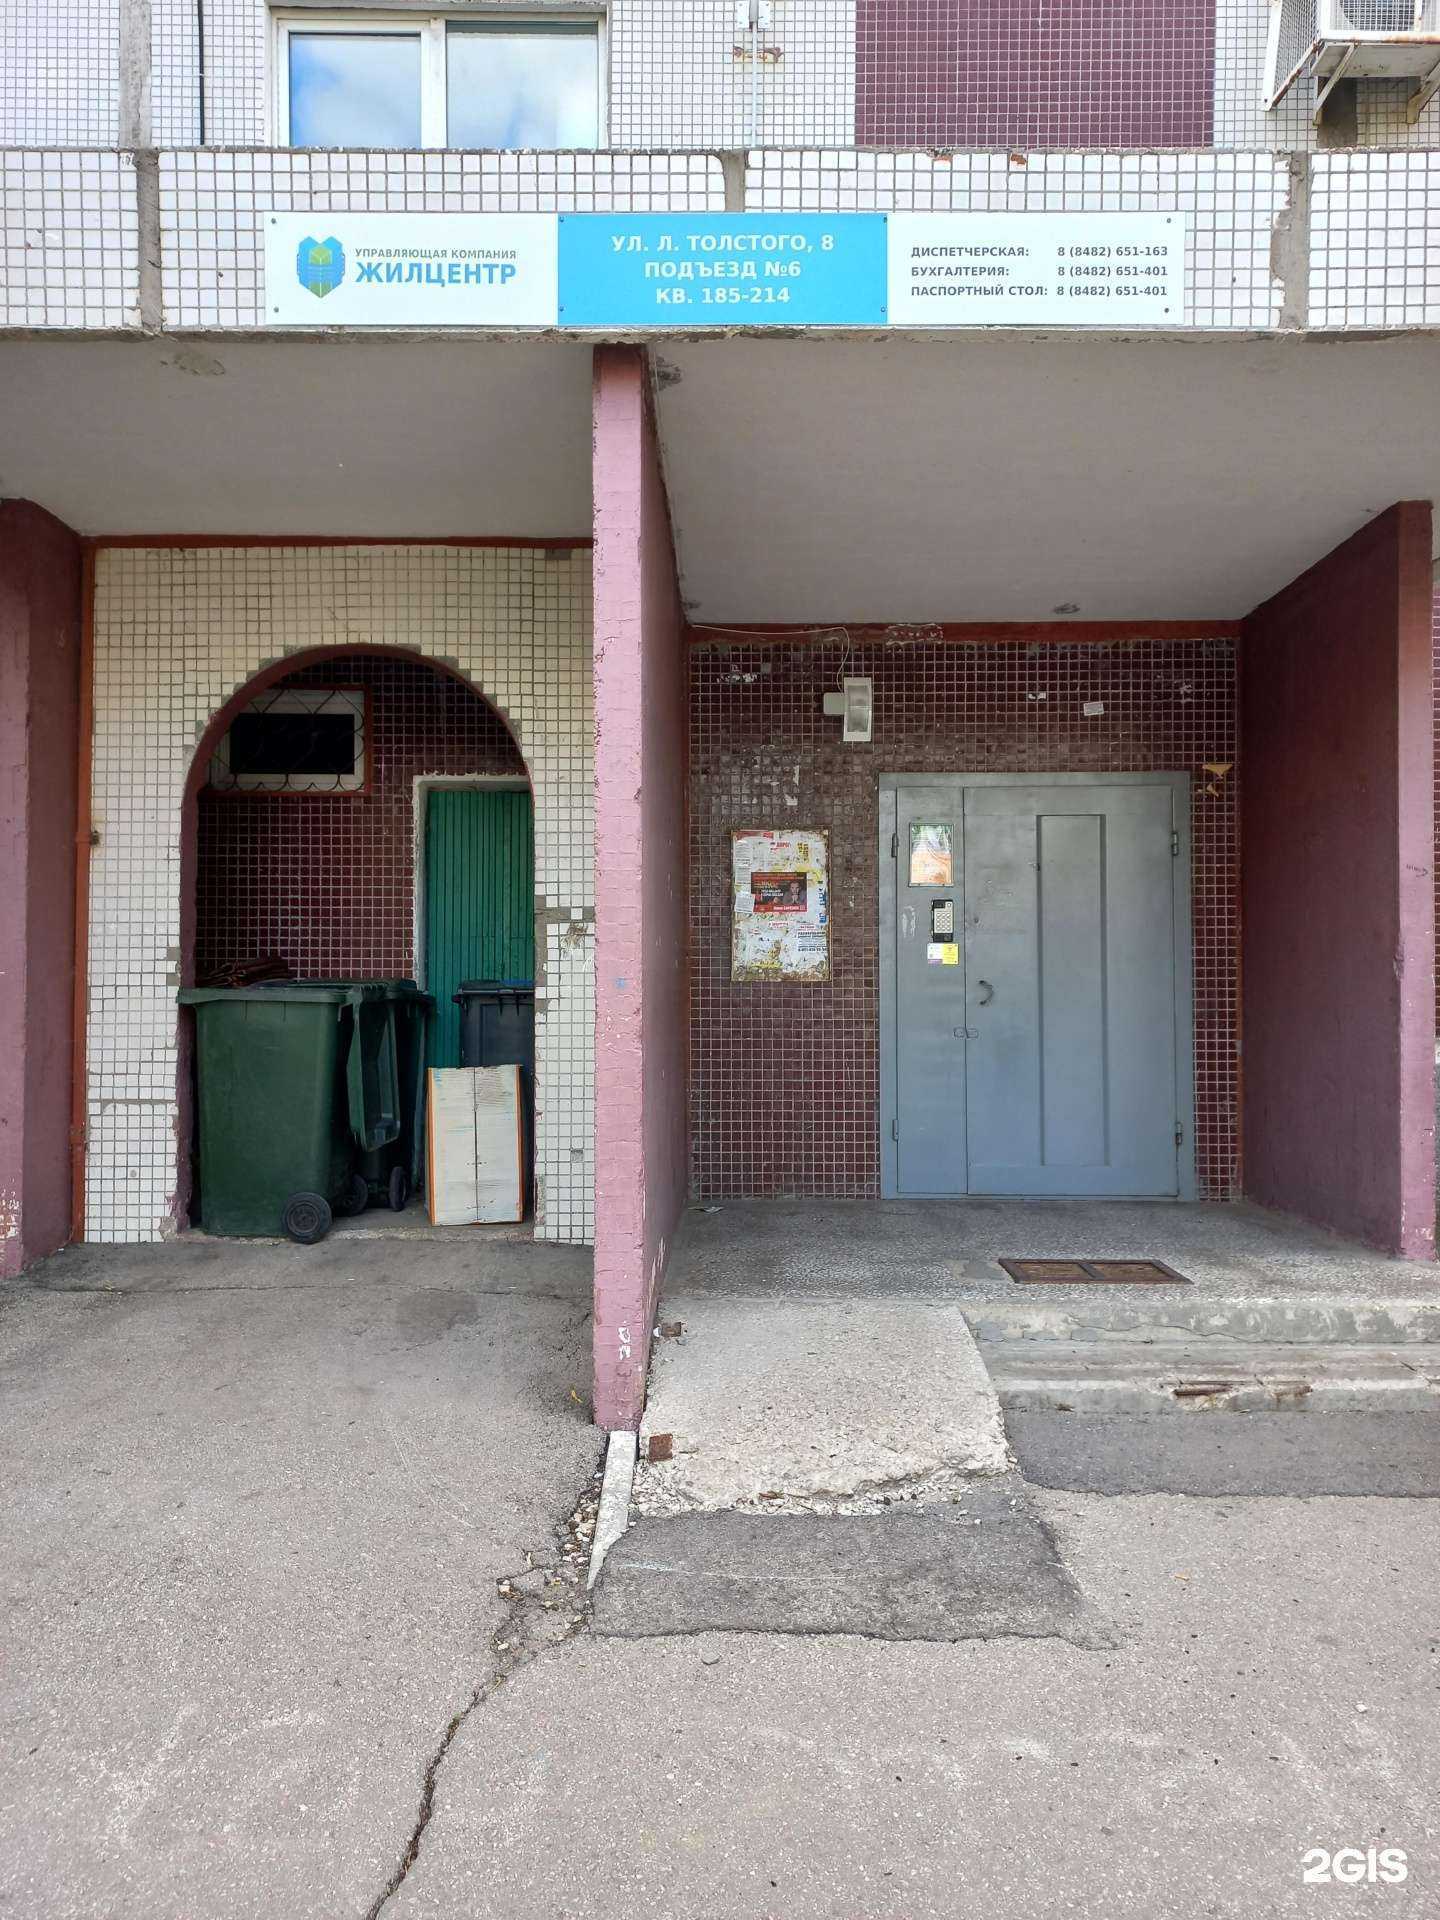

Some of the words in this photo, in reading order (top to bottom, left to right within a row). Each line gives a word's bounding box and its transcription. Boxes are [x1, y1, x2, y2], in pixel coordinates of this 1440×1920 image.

[612, 235, 648, 252] УЛ.
[657, 235, 679, 251] Л.
[686, 234, 813, 253] ТОЛСТОГО,
[820, 234, 834, 251] 8
[355, 248, 448, 260] УПРАВЛЯЮЩАЯ
[451, 248, 517, 259] КОМПАНИЯ
[911, 246, 1030, 258] ДИСПЕТЧЕРСКАЯ:
[1057, 246, 1065, 257] 8
[1069, 246, 1112, 258] (8482)
[1115, 246, 1168, 257] 651-163
[355, 262, 517, 287] ЖИЛЦЕНТР
[645, 261, 757, 280] ПОДЪЕЗД
[764, 260, 801, 277] №6
[911, 266, 1010, 278] БУХГАЛТЕРИЯ:
[1057, 266, 1065, 277] 8
[1069, 266, 1112, 278] (8482)
[1115, 266, 1168, 277] 651-401
[656, 287, 693, 304] КВ.
[702, 286, 791, 304] 185-214
[911, 284, 1004, 296] ПАСПОРТНЫЙ
[1008, 285, 1048, 296] СТОЛ:
[1056, 285, 1065, 296] 8
[1069, 285, 1111, 297] (8482)
[1115, 285, 1168, 296] 651-401
